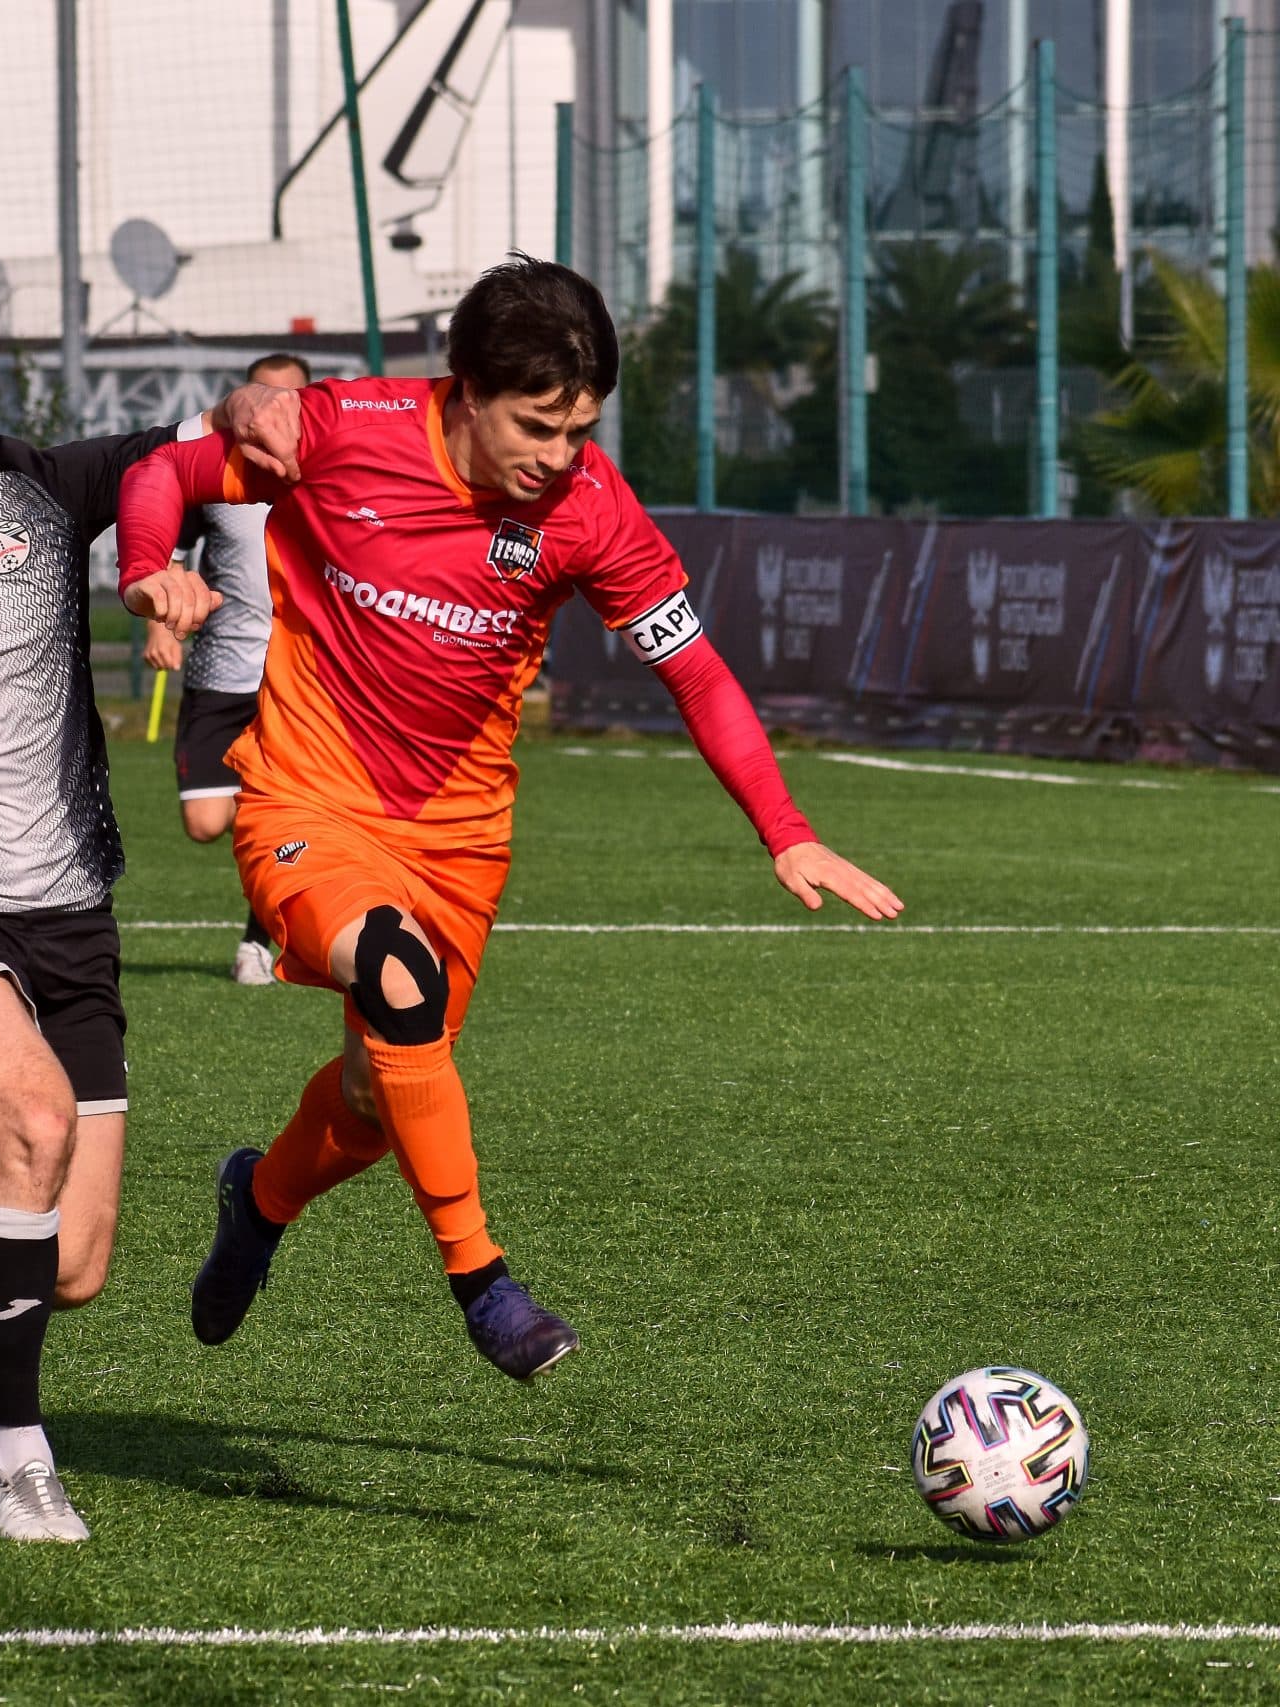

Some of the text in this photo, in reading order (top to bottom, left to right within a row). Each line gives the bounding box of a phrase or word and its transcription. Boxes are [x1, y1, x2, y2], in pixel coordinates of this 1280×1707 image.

[495, 538, 535, 568] ТЕМП
[324, 560, 523, 634] ПРОДИНВЕСТ
[634, 600, 694, 652] CAPT
